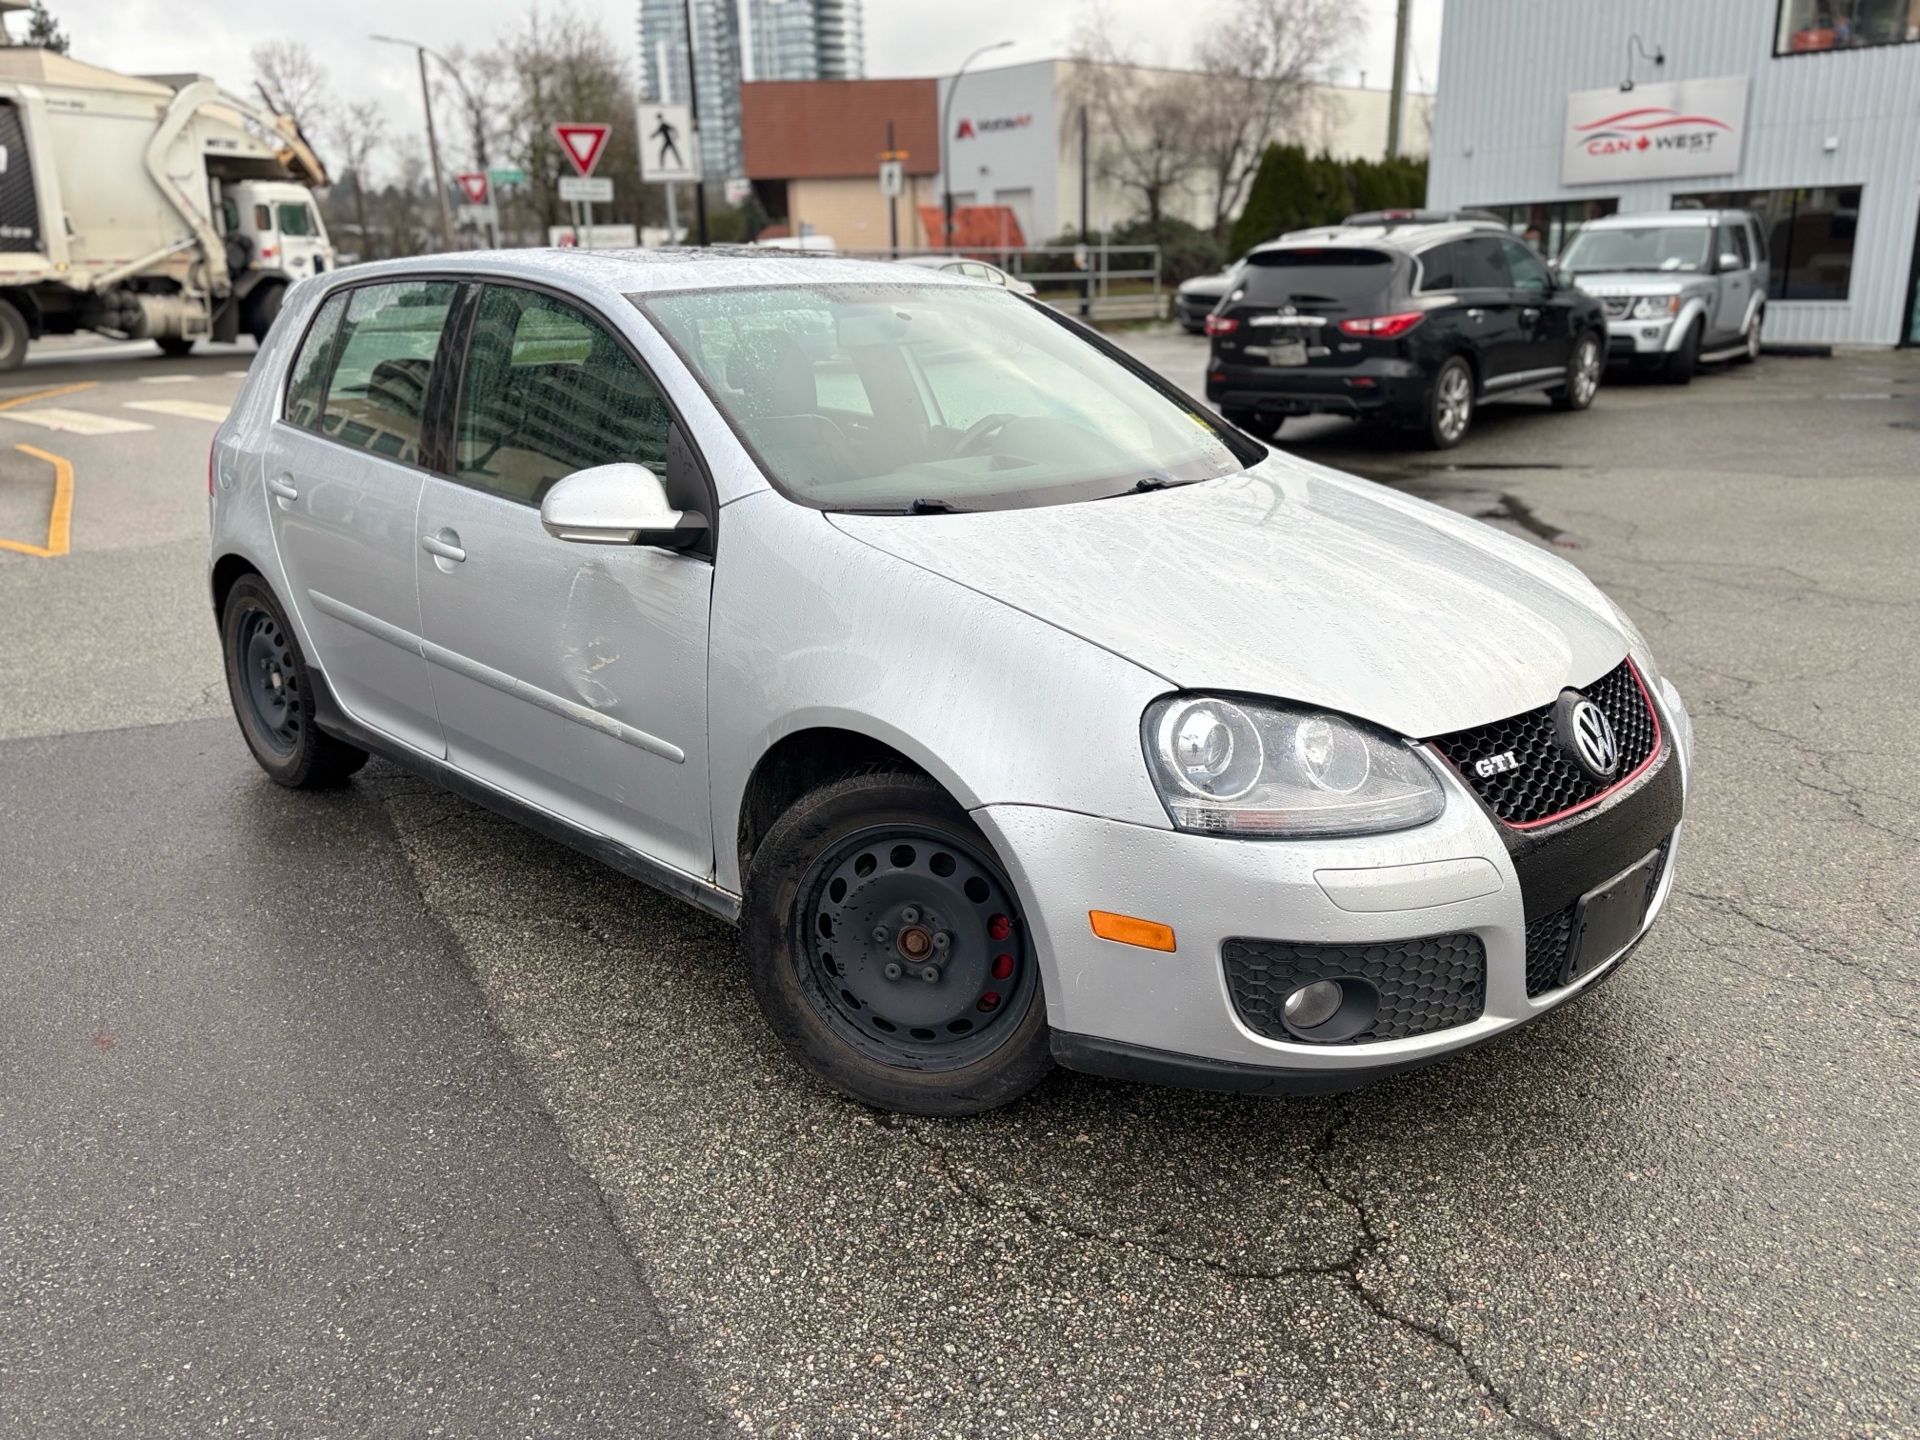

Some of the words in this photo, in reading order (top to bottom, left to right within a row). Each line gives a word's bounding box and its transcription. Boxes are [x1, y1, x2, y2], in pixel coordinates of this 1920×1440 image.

[1587, 140, 1631, 156] CAN
[1655, 132, 1717, 149] WEST
[1475, 751, 1519, 778] GTI
